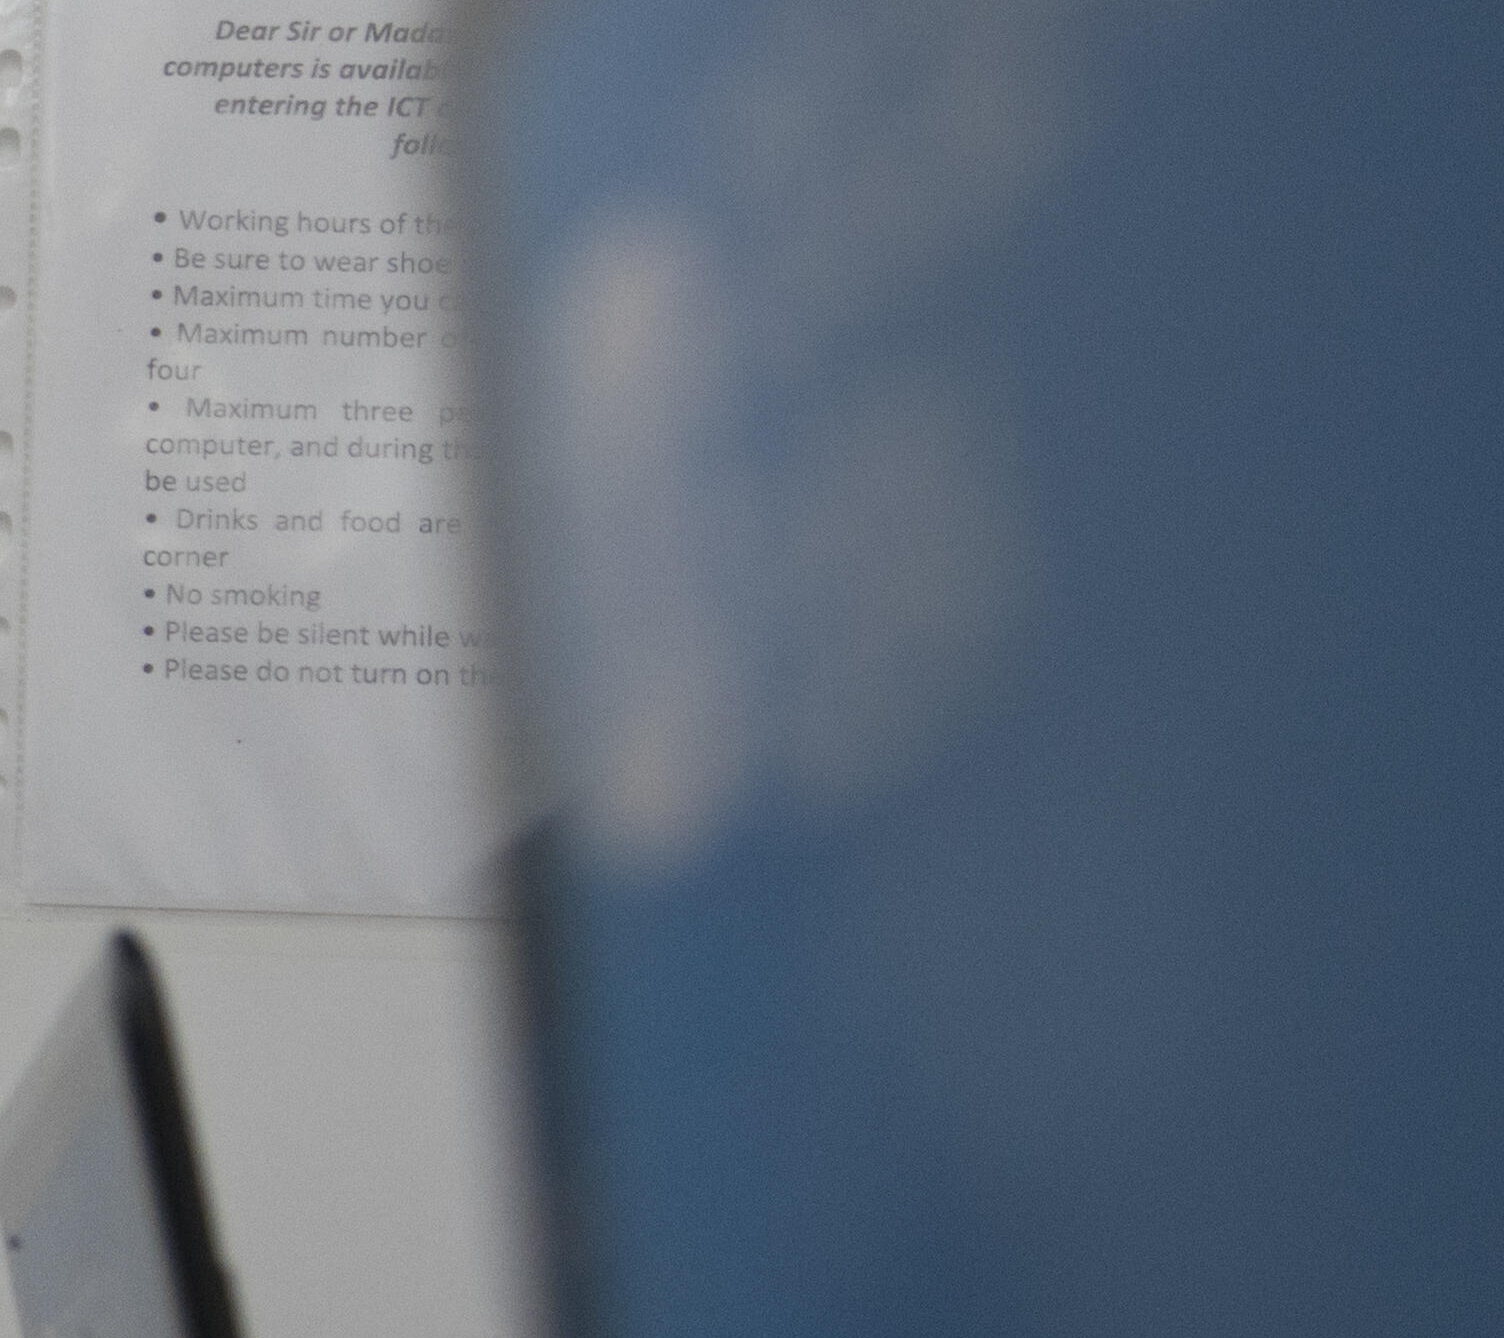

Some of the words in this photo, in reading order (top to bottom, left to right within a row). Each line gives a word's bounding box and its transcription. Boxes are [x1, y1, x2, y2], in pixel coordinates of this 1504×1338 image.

[214, 18, 281, 44] Dear
[285, 18, 322, 44] Sir
[326, 24, 358, 45] or
[161, 57, 305, 84] computers
[309, 56, 333, 81] is
[213, 93, 328, 123] entering
[333, 93, 380, 119] the
[386, 94, 429, 119] ICT
[177, 208, 291, 239] Working
[295, 210, 373, 237] hours
[377, 210, 409, 237] of
[173, 245, 208, 272] Be
[212, 250, 272, 273] sure
[277, 249, 308, 274] to
[312, 253, 380, 275] wear
[172, 283, 305, 309] Maximum
[311, 286, 374, 312] time
[378, 292, 430, 317] you
[174, 315, 309, 347] Maximum
[321, 324, 429, 350] number
[142, 435, 282, 465] computer,
[287, 434, 340, 460] and
[345, 433, 435, 466] during
[174, 506, 260, 533] Drinks
[272, 508, 325, 534] and
[338, 507, 403, 537] food
[417, 515, 462, 537] are
[164, 582, 205, 607] No
[209, 582, 323, 614] smoking
[163, 619, 250, 646] Please
[255, 620, 291, 647] be
[296, 621, 371, 648] silent
[376, 623, 452, 650] while
[163, 656, 250, 684] Please
[254, 658, 291, 684] do
[296, 662, 345, 685] not
[349, 662, 409, 687] turn
[413, 665, 451, 688] on
